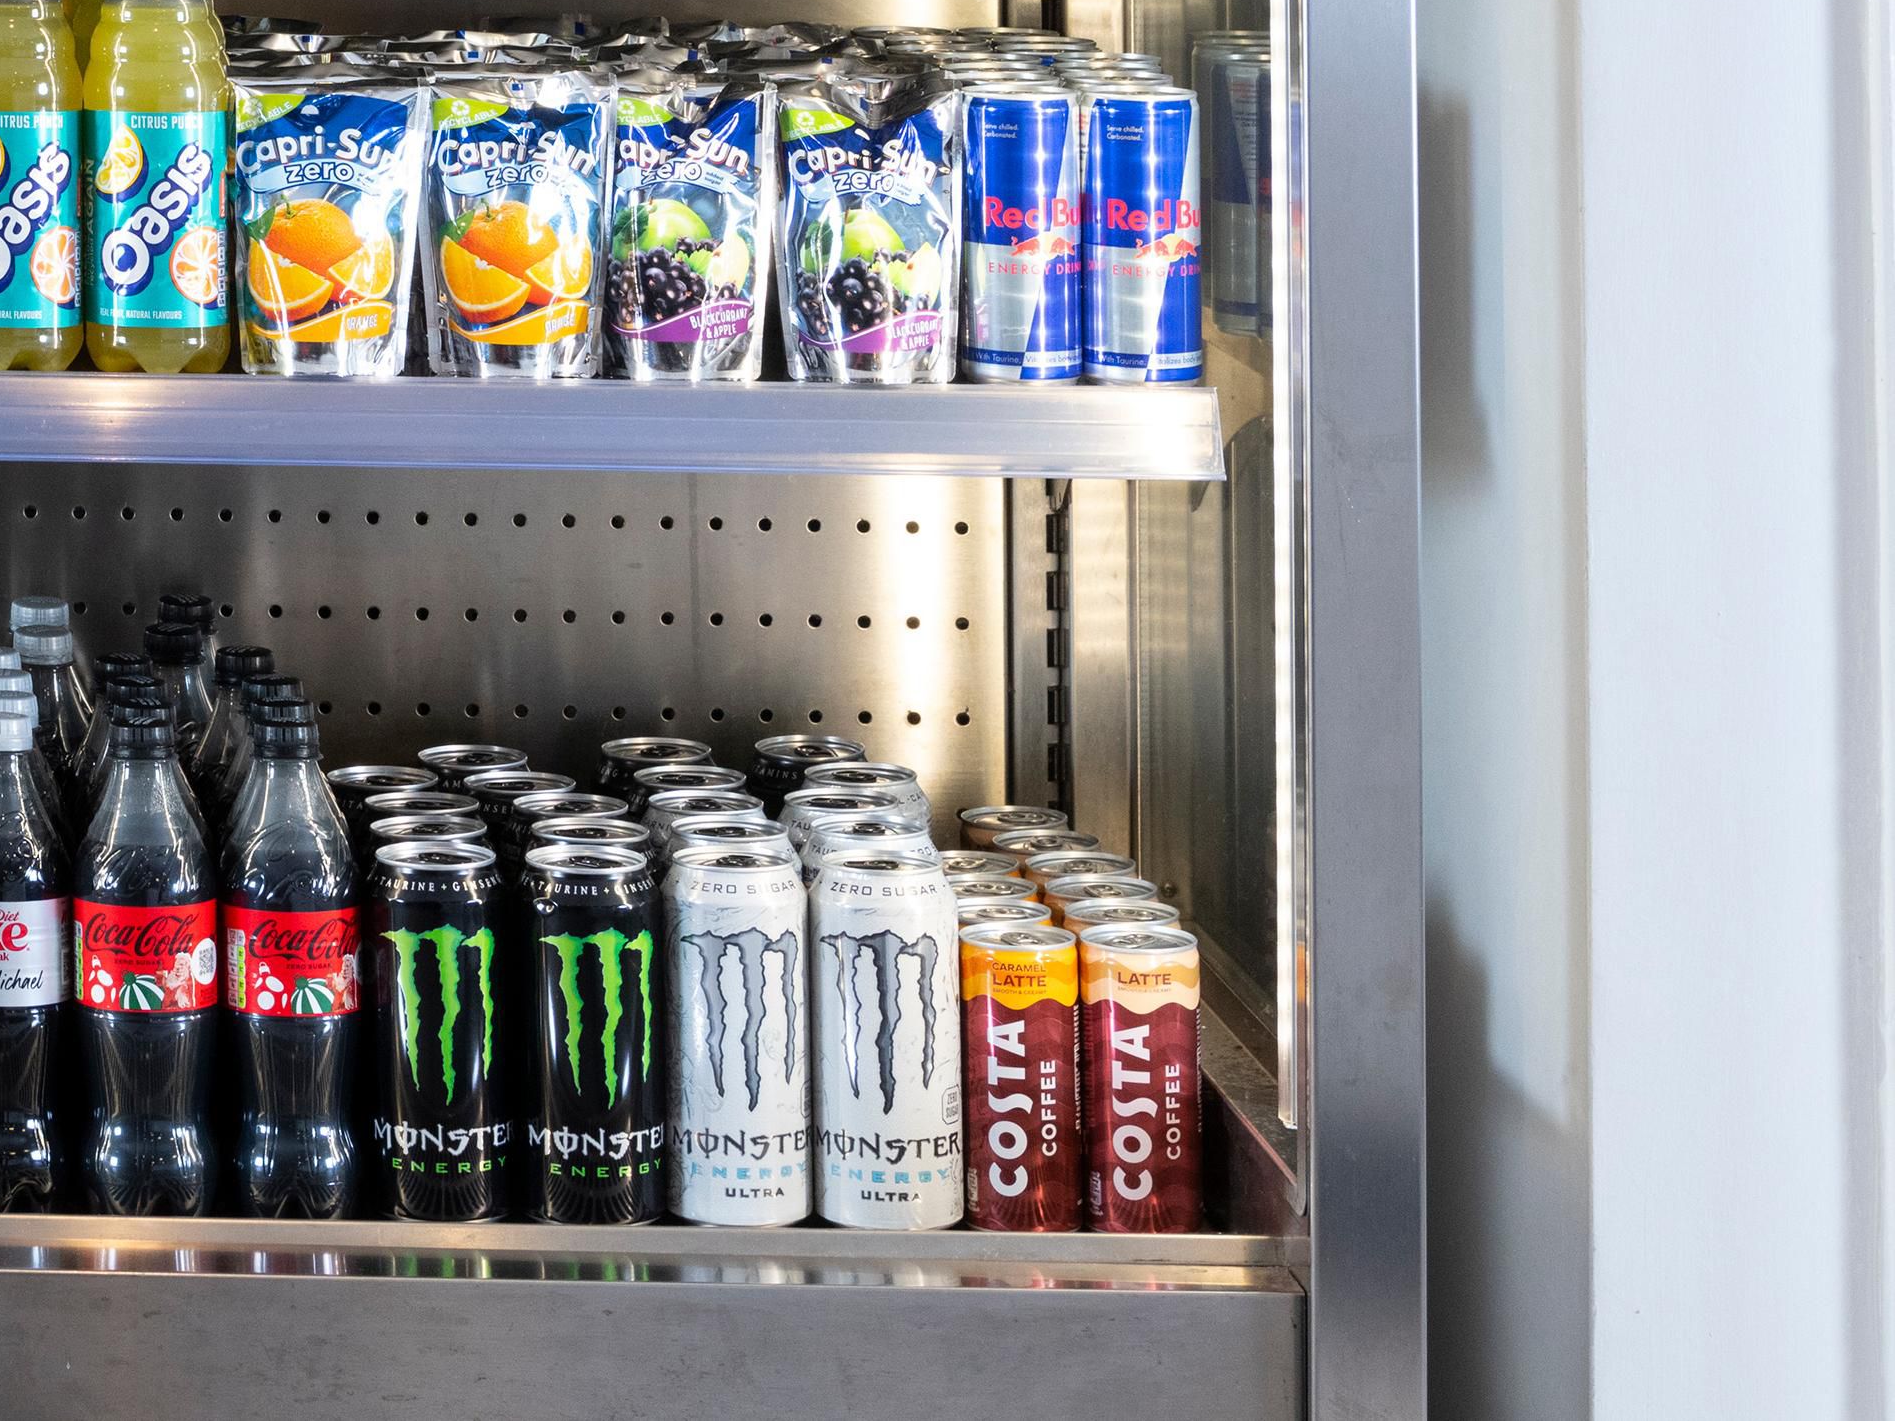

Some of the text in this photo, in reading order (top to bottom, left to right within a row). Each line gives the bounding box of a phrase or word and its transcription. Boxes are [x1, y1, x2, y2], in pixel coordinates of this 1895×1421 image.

[285, 162, 355, 183] zero
[101, 144, 212, 286] Oasis
[1107, 199, 1172, 231] Red
[830, 881, 940, 898] ZERO SUGAR
[84, 912, 200, 958] Coca-Cola
[992, 962, 1047, 973] CARAMEL
[992, 974, 1047, 987] LATTE
[1117, 972, 1173, 986] LATTE
[988, 1019, 1034, 1197] COSTA
[1041, 1059, 1058, 1157] COFFEE
[1111, 1024, 1159, 1201] COSTA
[1166, 1062, 1181, 1161] COFFEE
[816, 1129, 961, 1165] MONSTER
[392, 1156, 506, 1174] ENERGY
[550, 1158, 662, 1178] ENERGY
[830, 1164, 950, 1184] ENERGY
[725, 1186, 785, 1199] ULTRA
[861, 1189, 922, 1202] ULTRA
